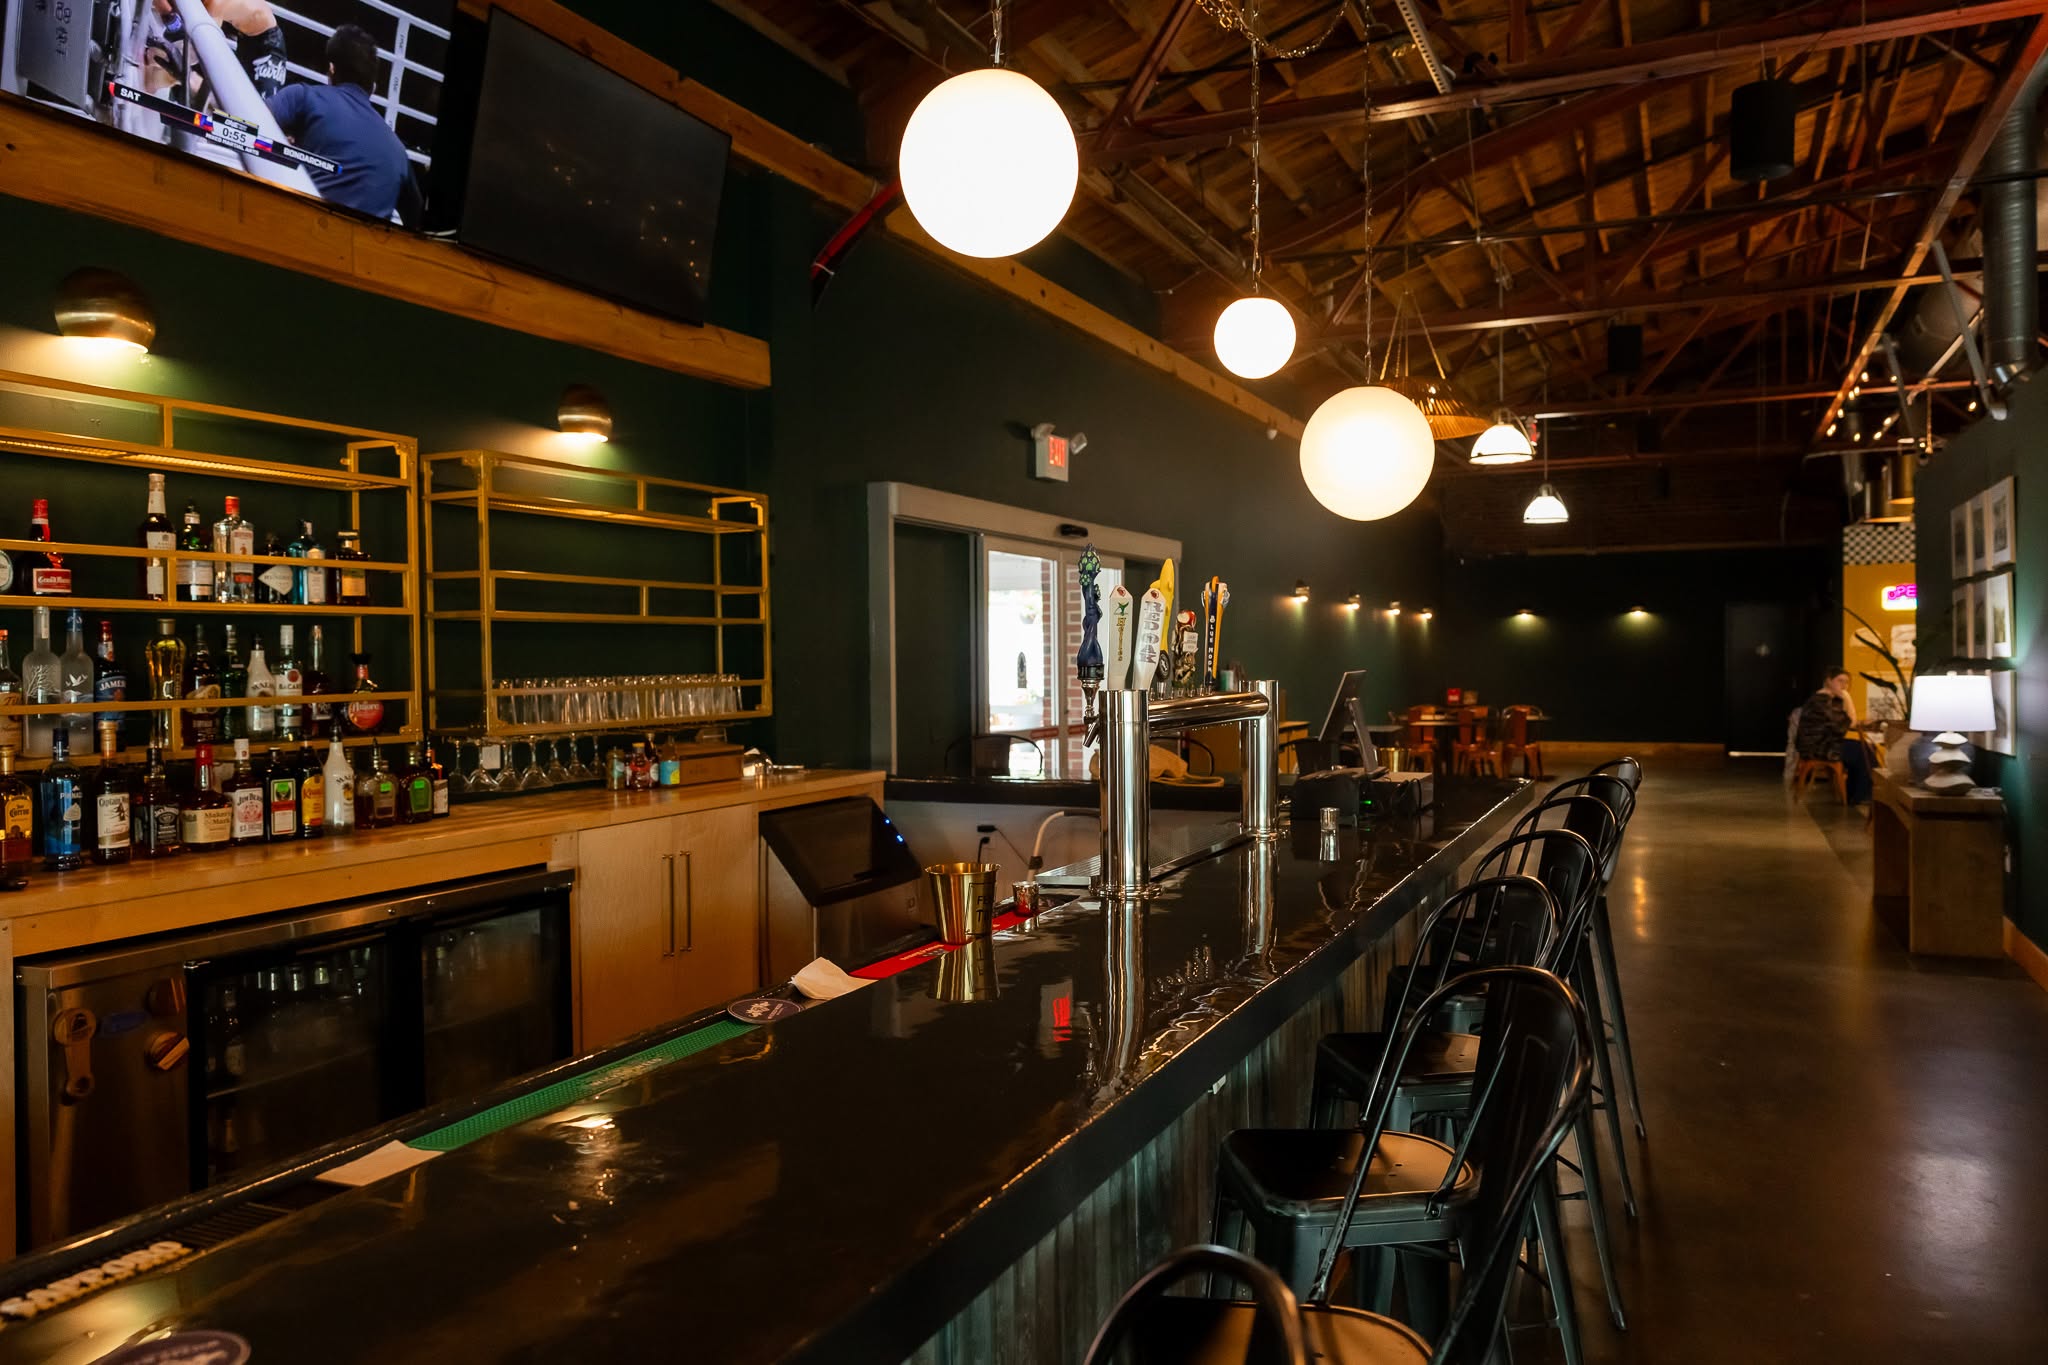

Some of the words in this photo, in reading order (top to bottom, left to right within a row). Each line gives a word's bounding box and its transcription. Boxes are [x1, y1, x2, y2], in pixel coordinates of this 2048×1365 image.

[120, 87, 141, 102] SAT
[222, 127, 247, 143] 0:55
[1049, 436, 1066, 467] EXIT
[1888, 585, 1917, 600] OPE
